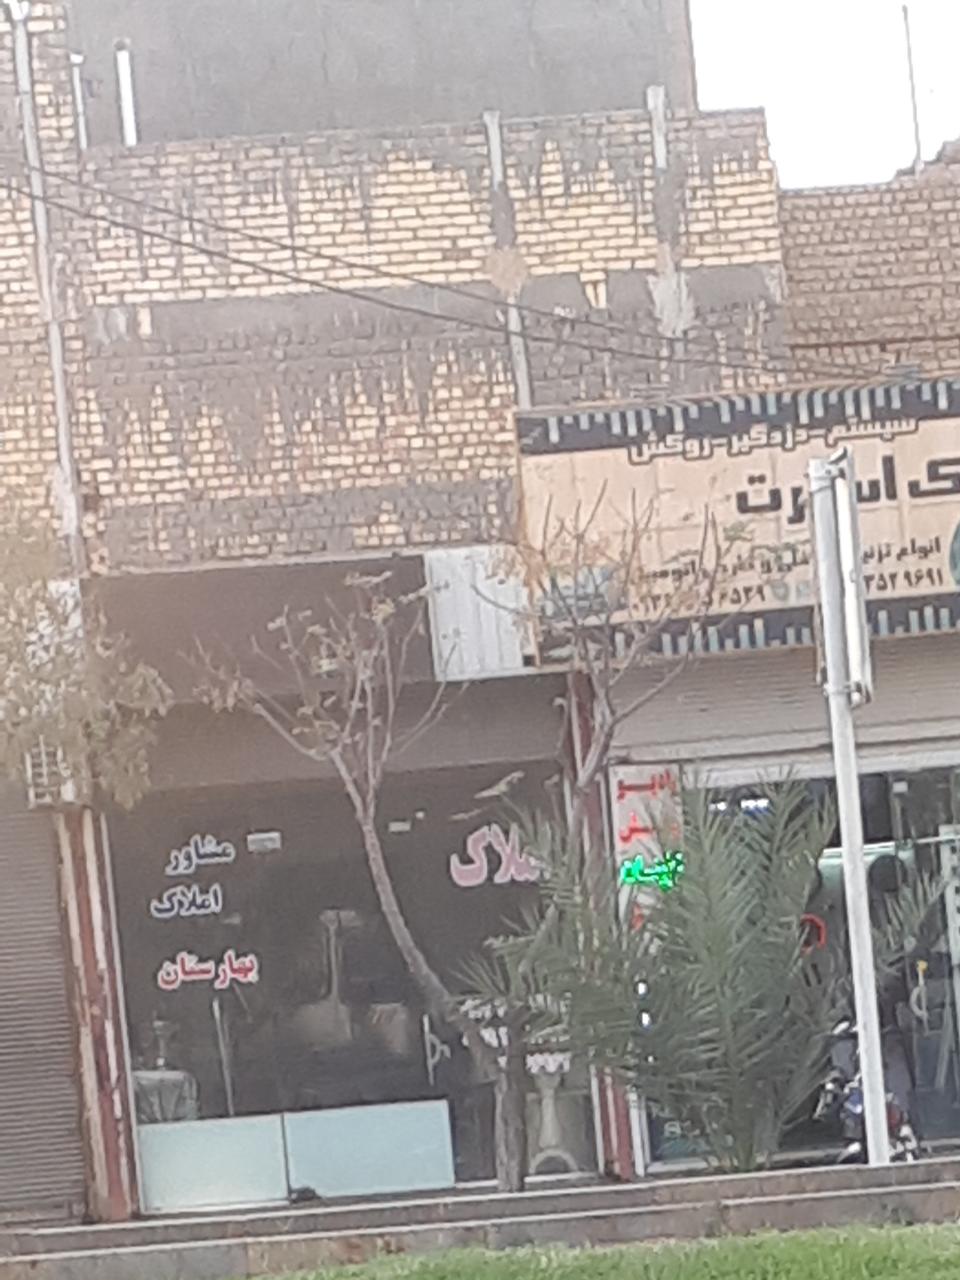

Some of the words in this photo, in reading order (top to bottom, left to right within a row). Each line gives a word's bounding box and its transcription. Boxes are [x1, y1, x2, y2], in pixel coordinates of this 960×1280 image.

[736, 455, 897, 524] اسرت
[896, 536, 941, 561] انواع
[165, 834, 236, 876] مشاور
[450, 822, 548, 888] ملاک
[150, 883, 223, 917] املاک
[158, 949, 259, 989] بهارستان
